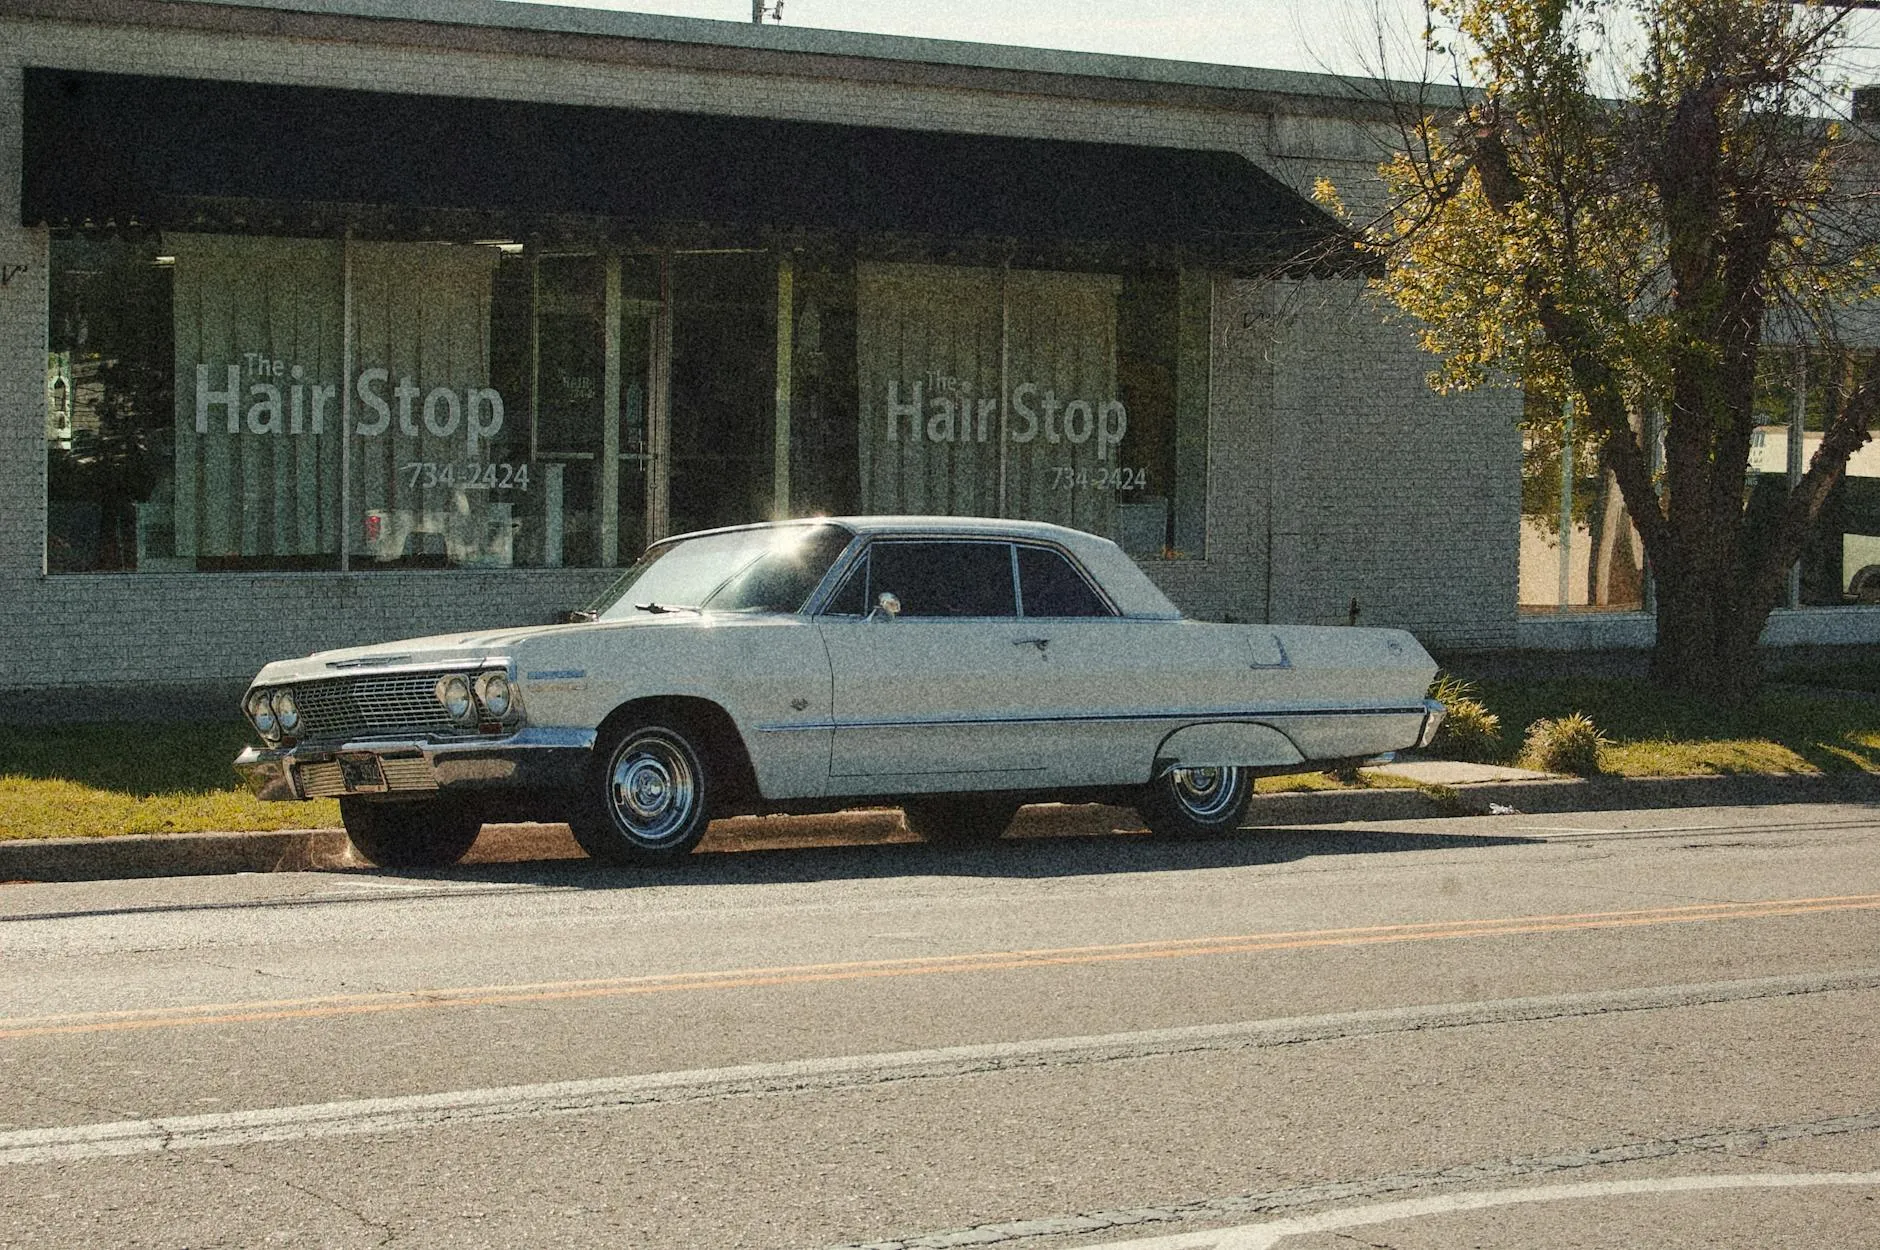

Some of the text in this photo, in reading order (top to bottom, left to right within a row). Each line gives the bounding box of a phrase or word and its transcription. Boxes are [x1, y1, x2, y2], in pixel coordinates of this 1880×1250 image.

[244, 353, 285, 377] The
[926, 370, 957, 392] The
[195, 363, 505, 455] Hair Stop
[887, 379, 1128, 460] Hair Stop
[407, 462, 530, 491] 734-2424
[1050, 466, 1147, 491] 734-2424
